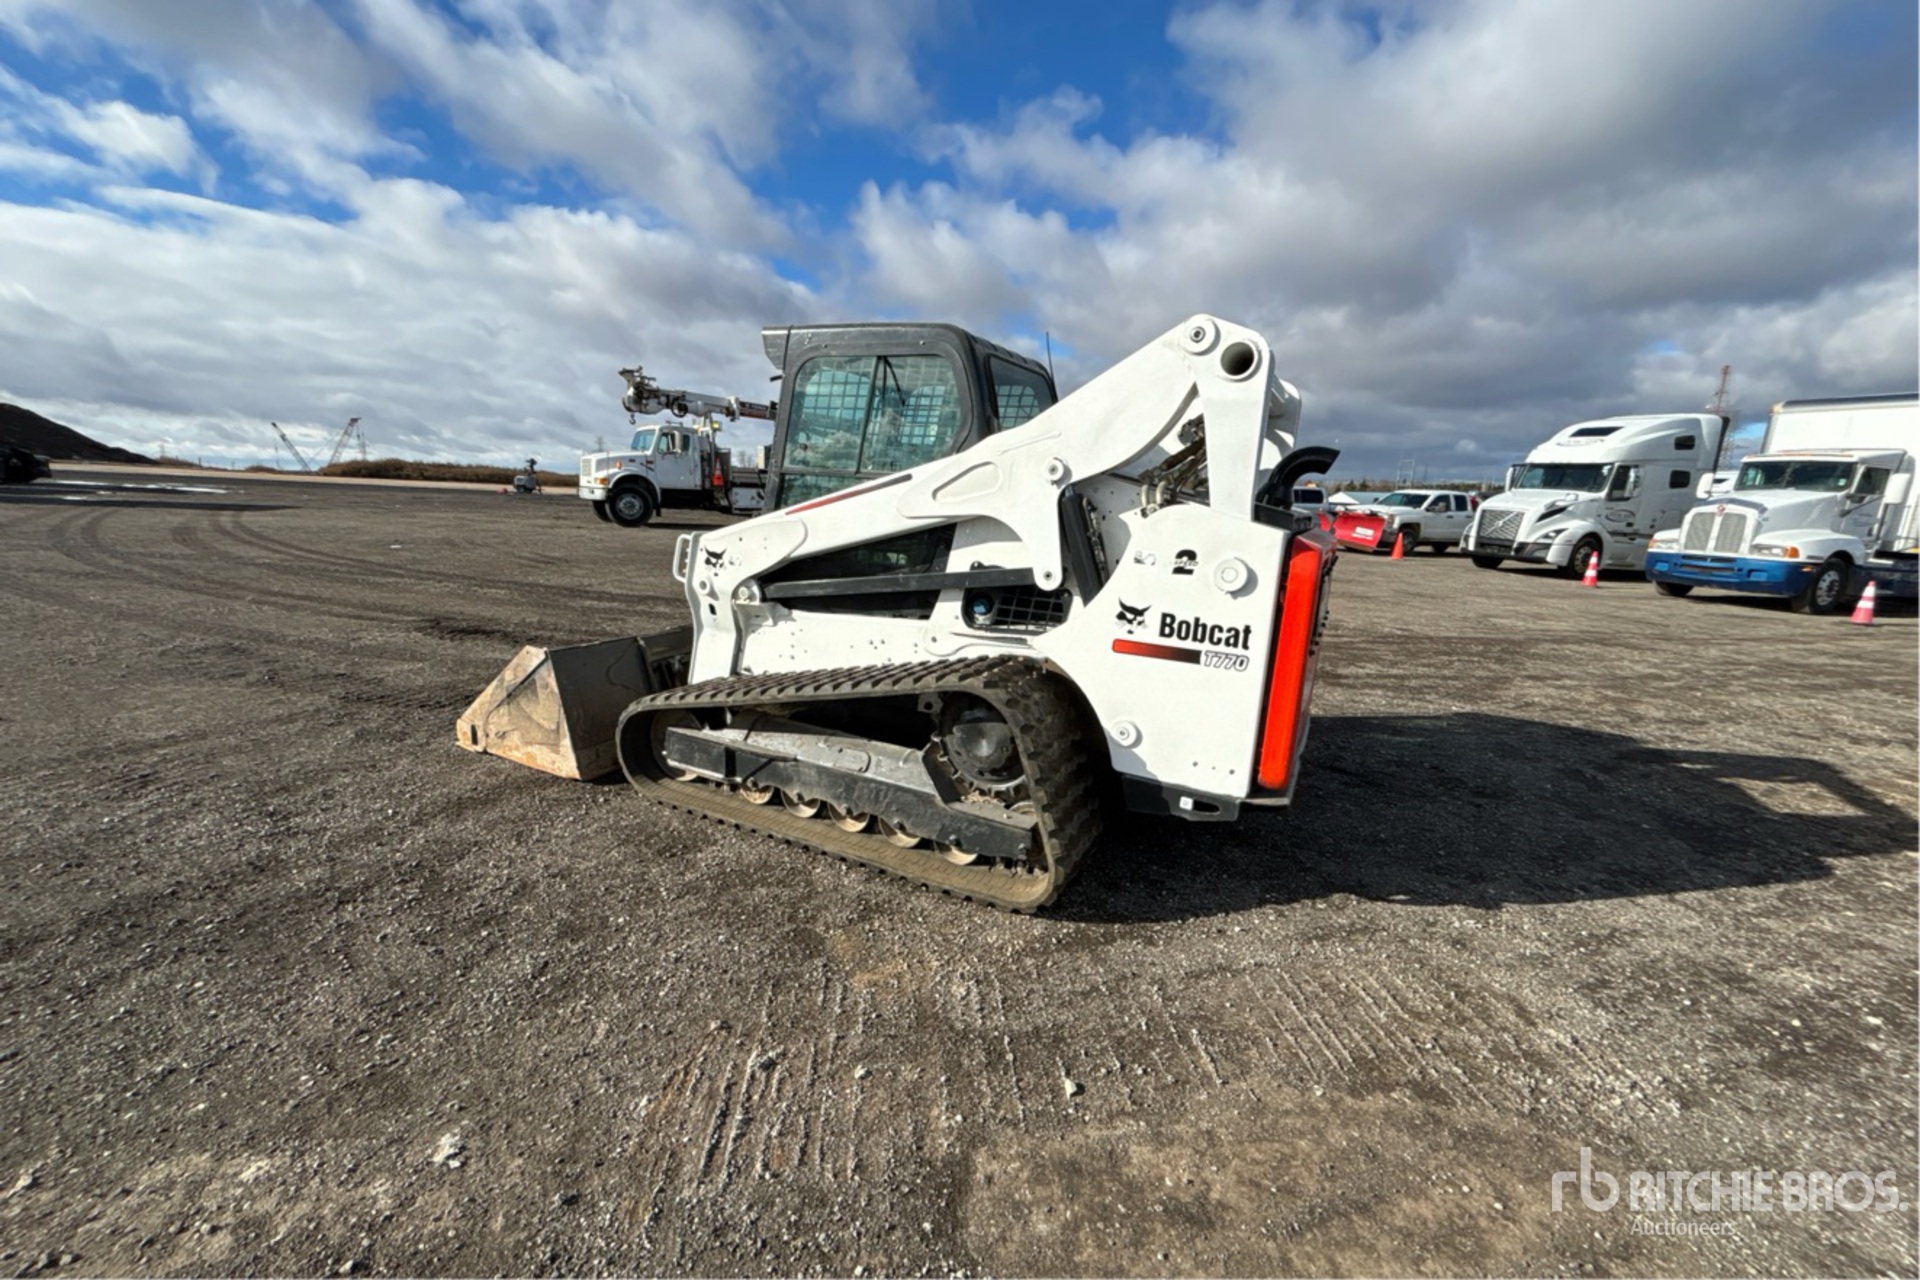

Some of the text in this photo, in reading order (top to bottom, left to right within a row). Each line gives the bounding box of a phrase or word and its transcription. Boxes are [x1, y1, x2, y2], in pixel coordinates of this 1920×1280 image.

[1172, 549, 1198, 575] 2
[1159, 612, 1252, 650] Bobcat
[1204, 650, 1250, 672] T770
